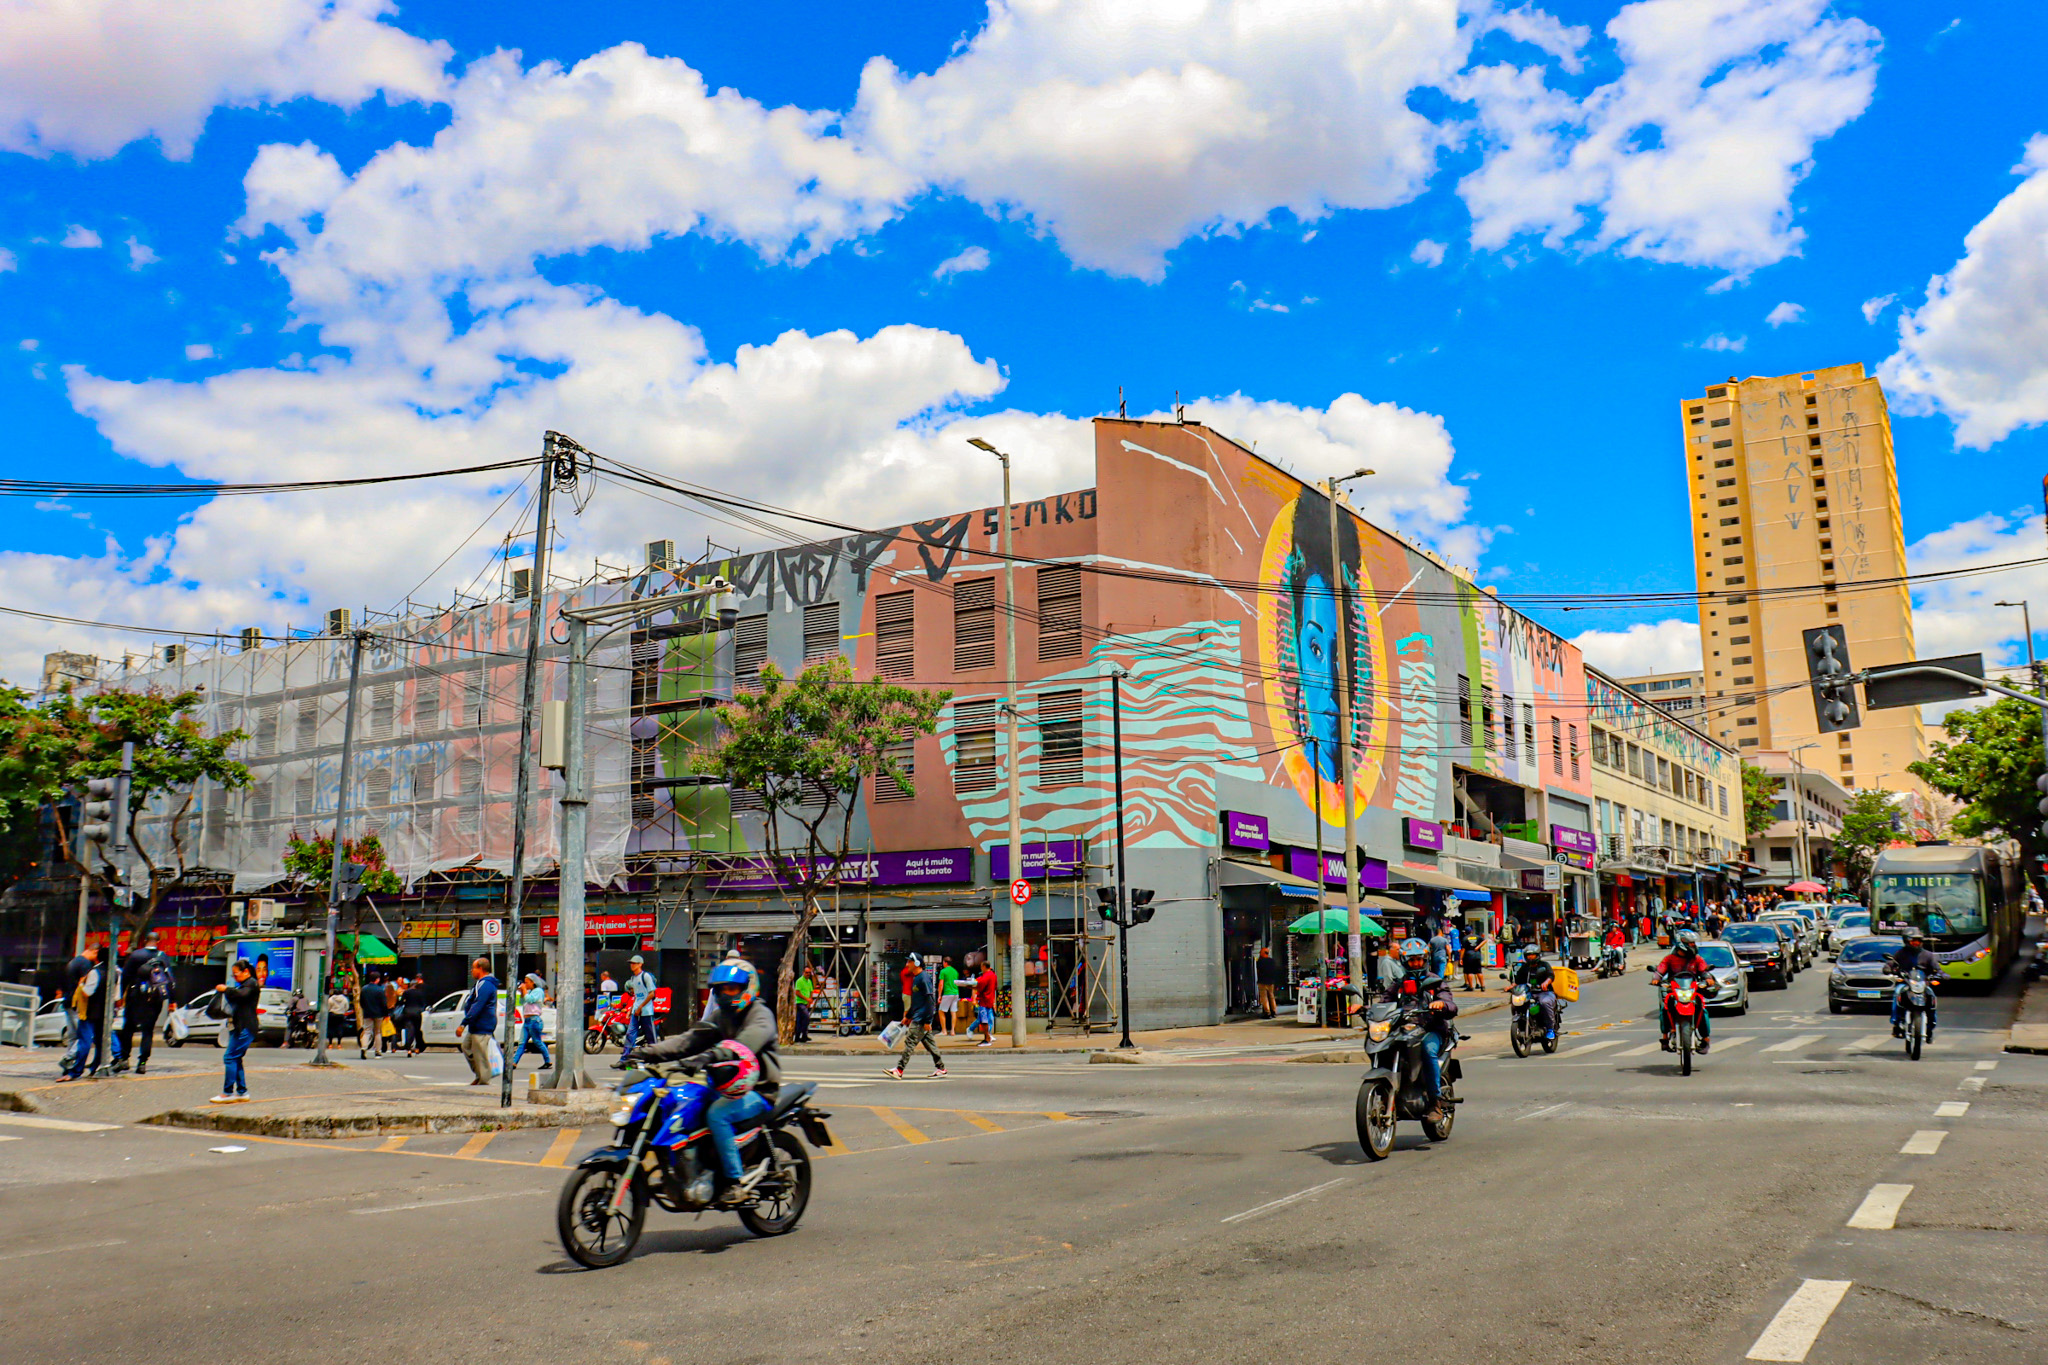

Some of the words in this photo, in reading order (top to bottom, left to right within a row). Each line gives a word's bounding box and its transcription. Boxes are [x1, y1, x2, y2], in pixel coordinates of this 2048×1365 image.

[1030, 851, 1056, 859] mundo
[906, 858, 924, 868] Aqui
[924, 858, 930, 866] é
[930, 857, 954, 866] muito
[1022, 859, 1062, 868] tecnolgia
[906, 867, 925, 876] mais
[925, 867, 953, 875] barato
[1888, 878, 1898, 887] 61
[489, 923, 496, 933] E
